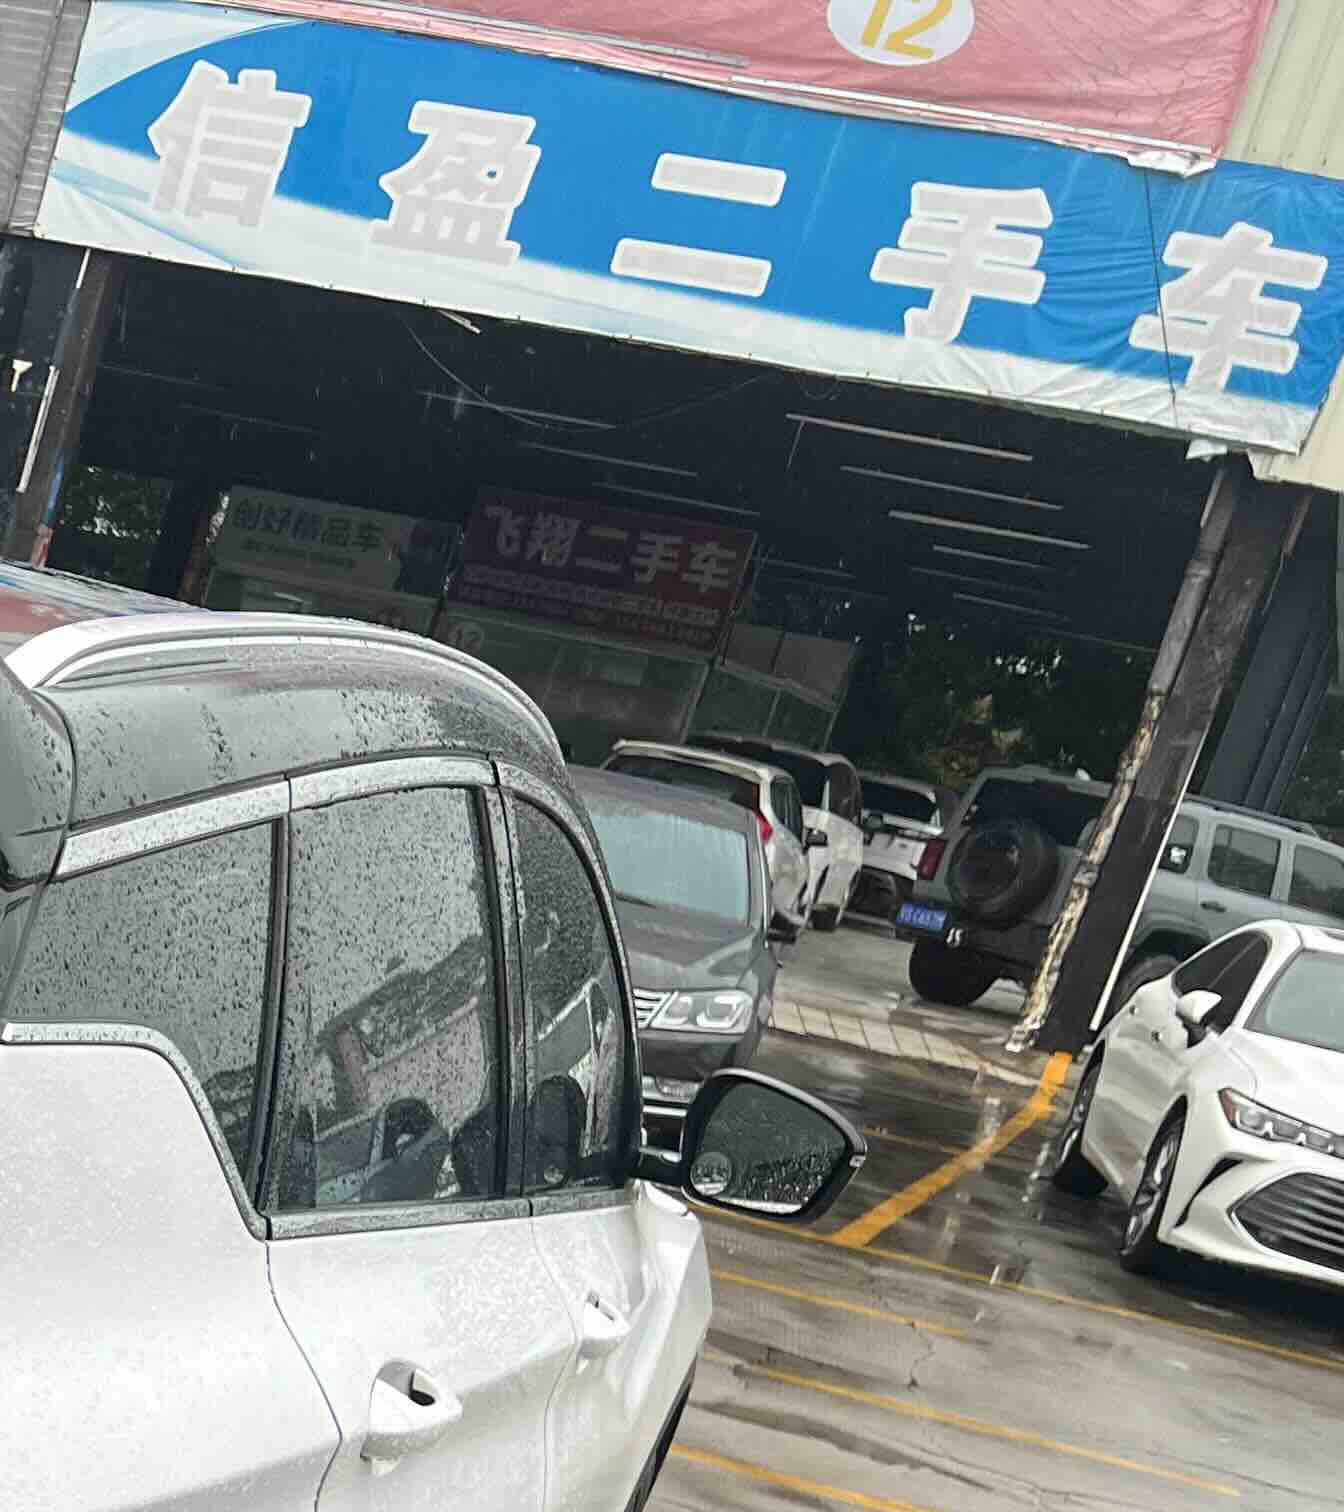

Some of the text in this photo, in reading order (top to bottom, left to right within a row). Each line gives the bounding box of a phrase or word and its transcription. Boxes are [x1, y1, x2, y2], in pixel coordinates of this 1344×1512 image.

[862, 0, 948, 63] 12
[148, 59, 1328, 400] 信盈二手车
[484, 504, 738, 592] 飞翔二手车
